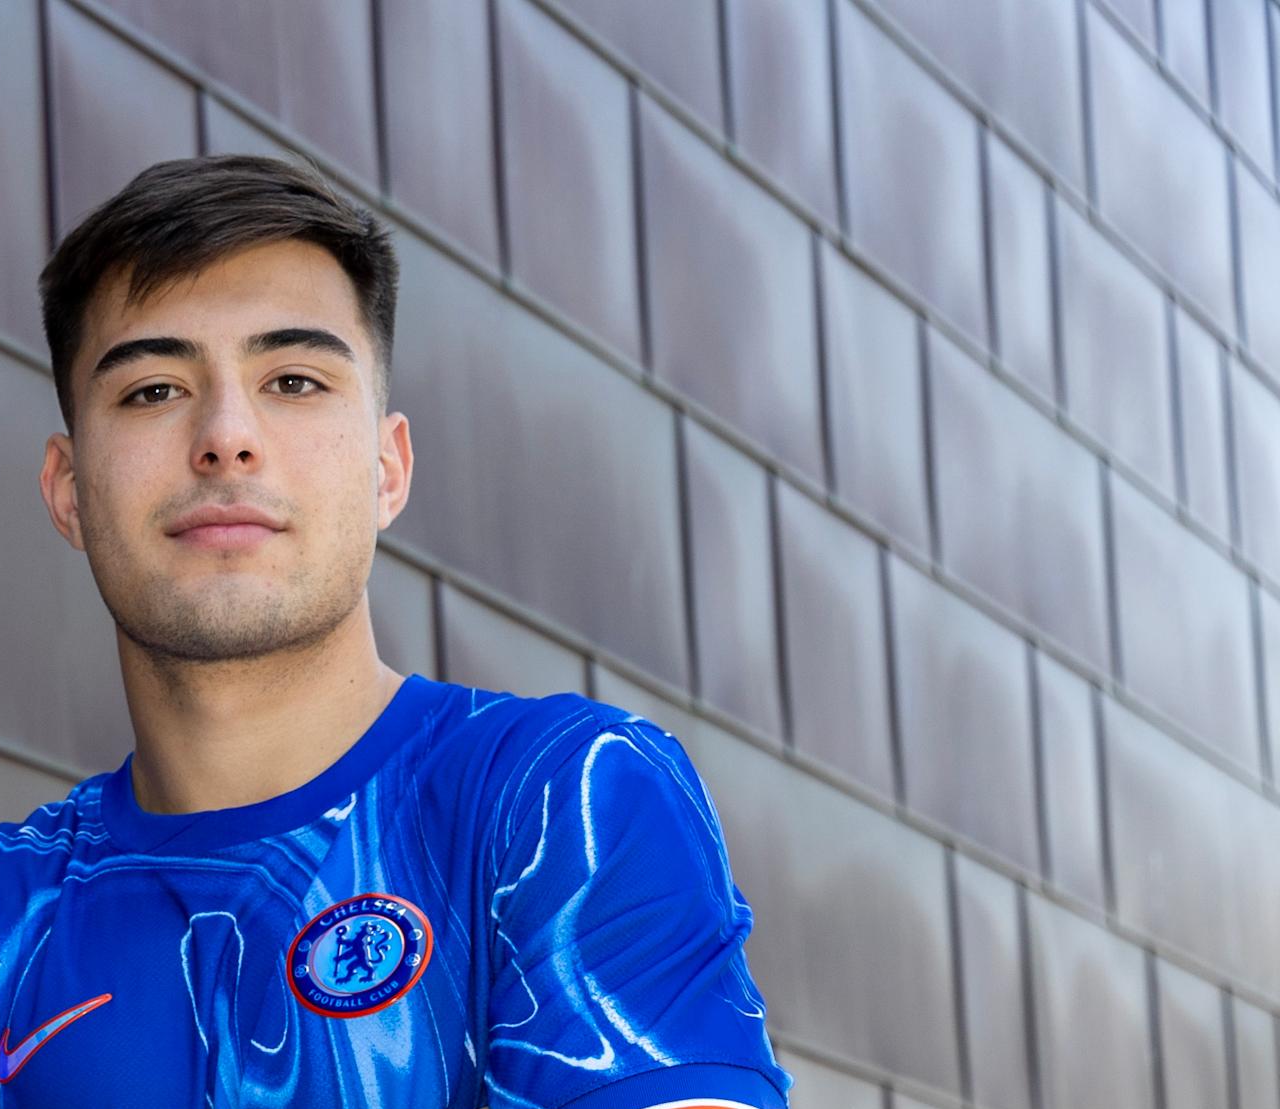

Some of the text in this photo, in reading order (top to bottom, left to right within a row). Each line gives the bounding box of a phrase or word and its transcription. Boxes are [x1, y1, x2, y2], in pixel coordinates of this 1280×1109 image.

[320, 899, 407, 926] CHELSEA
[308, 981, 399, 1007] FOOTBALL CLUB
